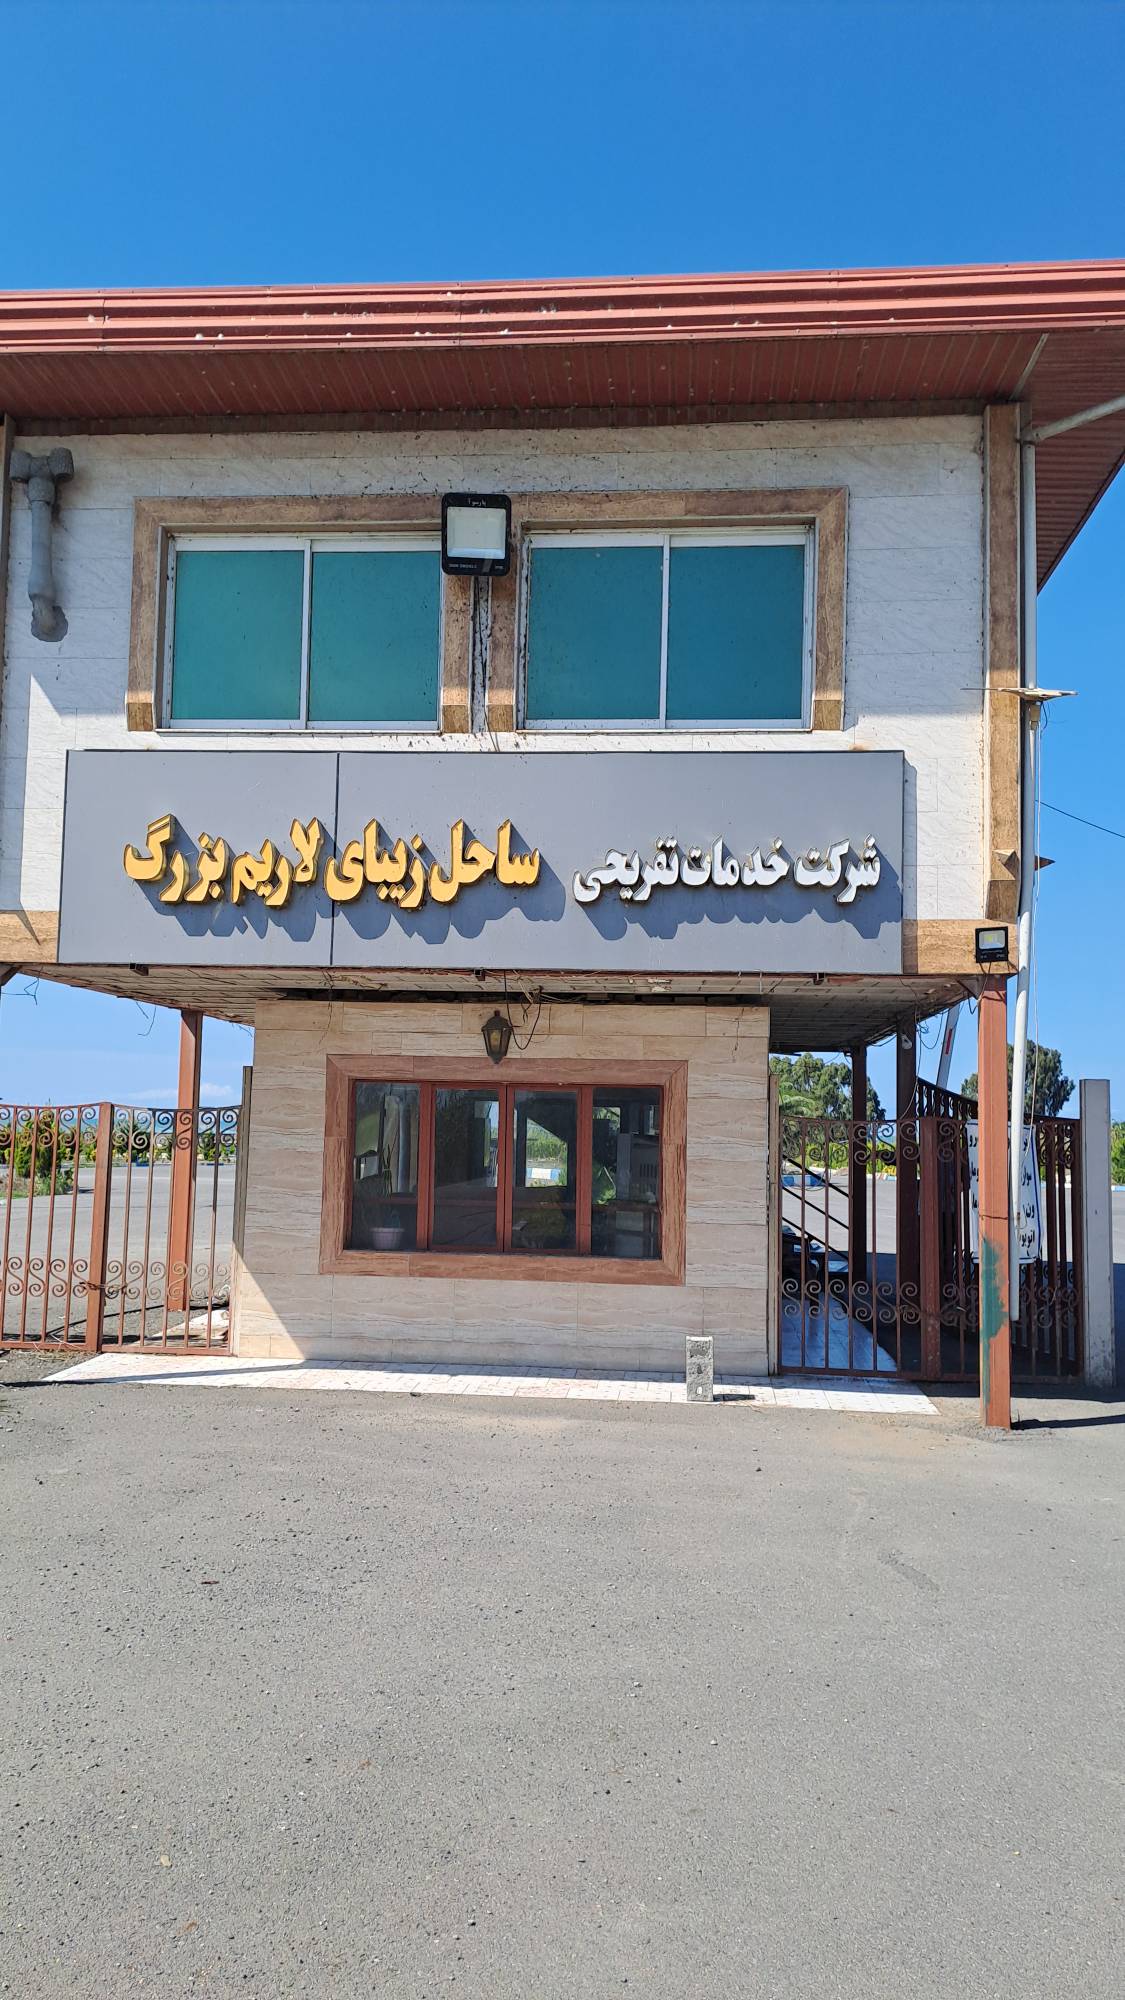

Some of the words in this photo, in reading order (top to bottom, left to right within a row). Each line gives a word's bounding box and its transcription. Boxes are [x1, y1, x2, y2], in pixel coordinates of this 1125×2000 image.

[123, 814, 230, 903] بزرگ
[231, 817, 325, 908] لاریم
[323, 818, 427, 910] زیبای
[429, 818, 542, 903] ساحل
[572, 835, 680, 903] تفریحی
[681, 833, 790, 888] خدمات
[794, 833, 881, 903] شرکت
